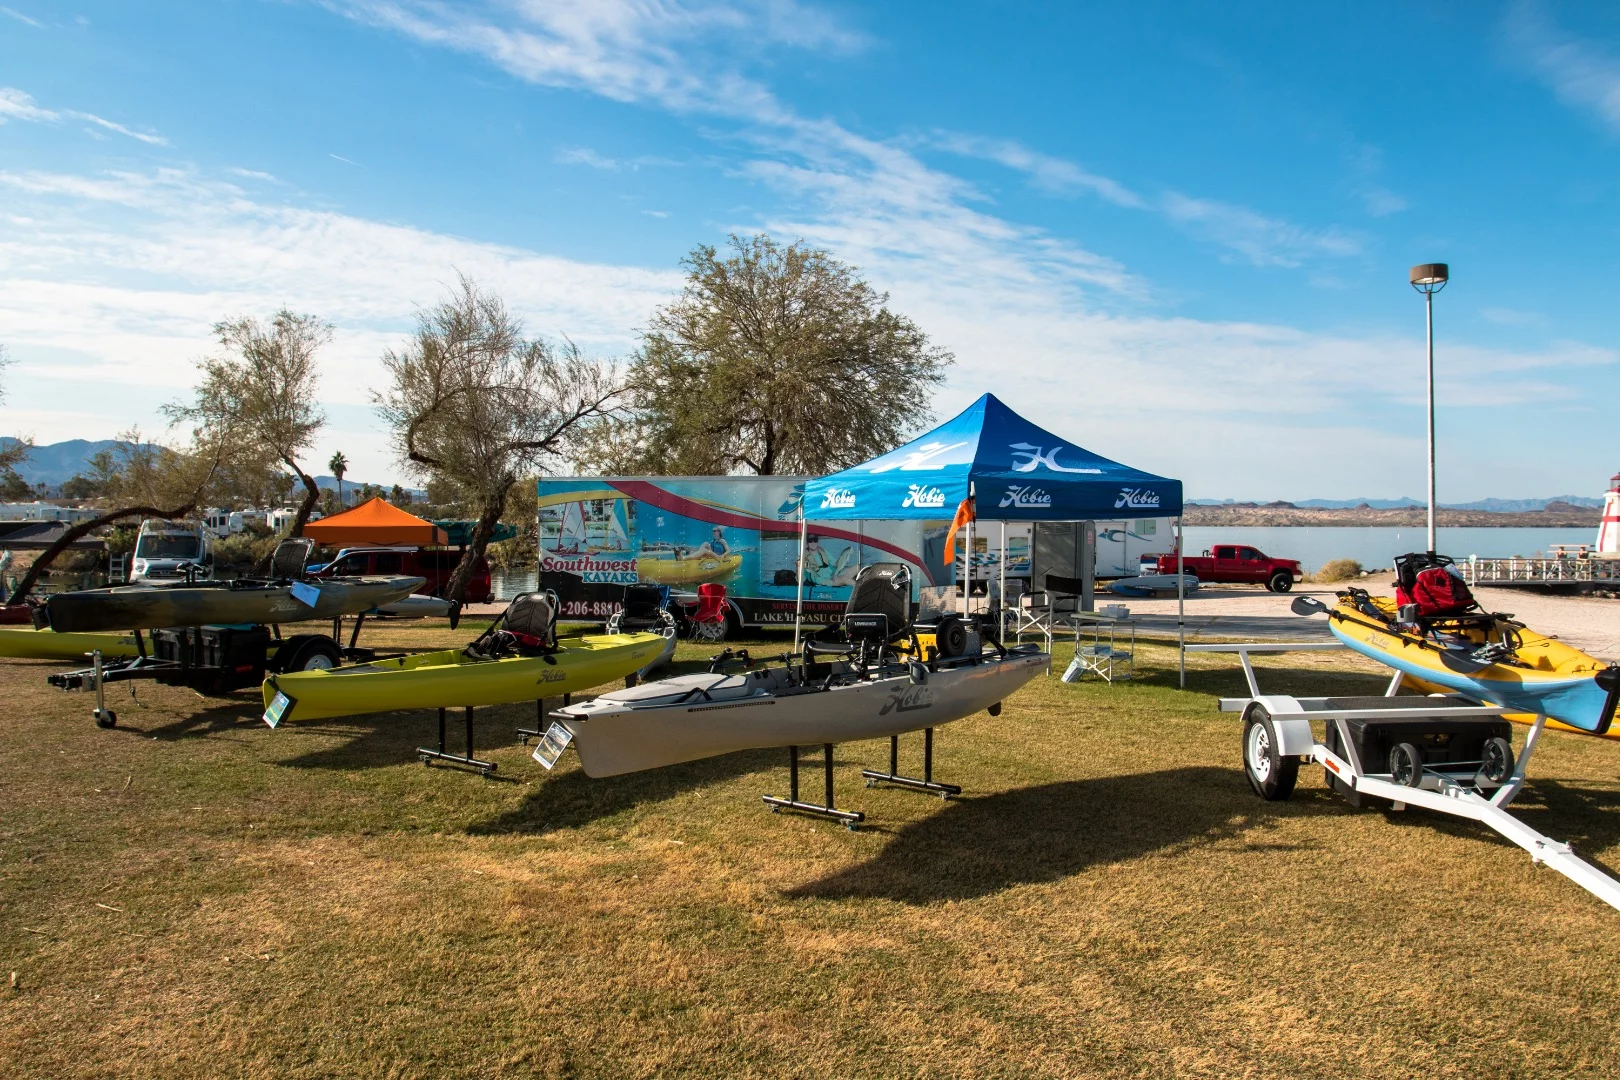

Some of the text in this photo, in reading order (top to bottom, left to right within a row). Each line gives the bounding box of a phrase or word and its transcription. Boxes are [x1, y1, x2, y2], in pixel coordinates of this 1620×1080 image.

[820, 488, 856, 509] Hobie
[902, 484, 945, 508] Hobie
[998, 485, 1051, 508] Hobie
[1114, 488, 1160, 509] Hobie
[541, 556, 637, 572] Southwest
[583, 572, 638, 583] KAYAKS
[754, 612, 784, 621] LAKE
[772, 602, 799, 610] SERVIN
[878, 685, 934, 715] Hobie
